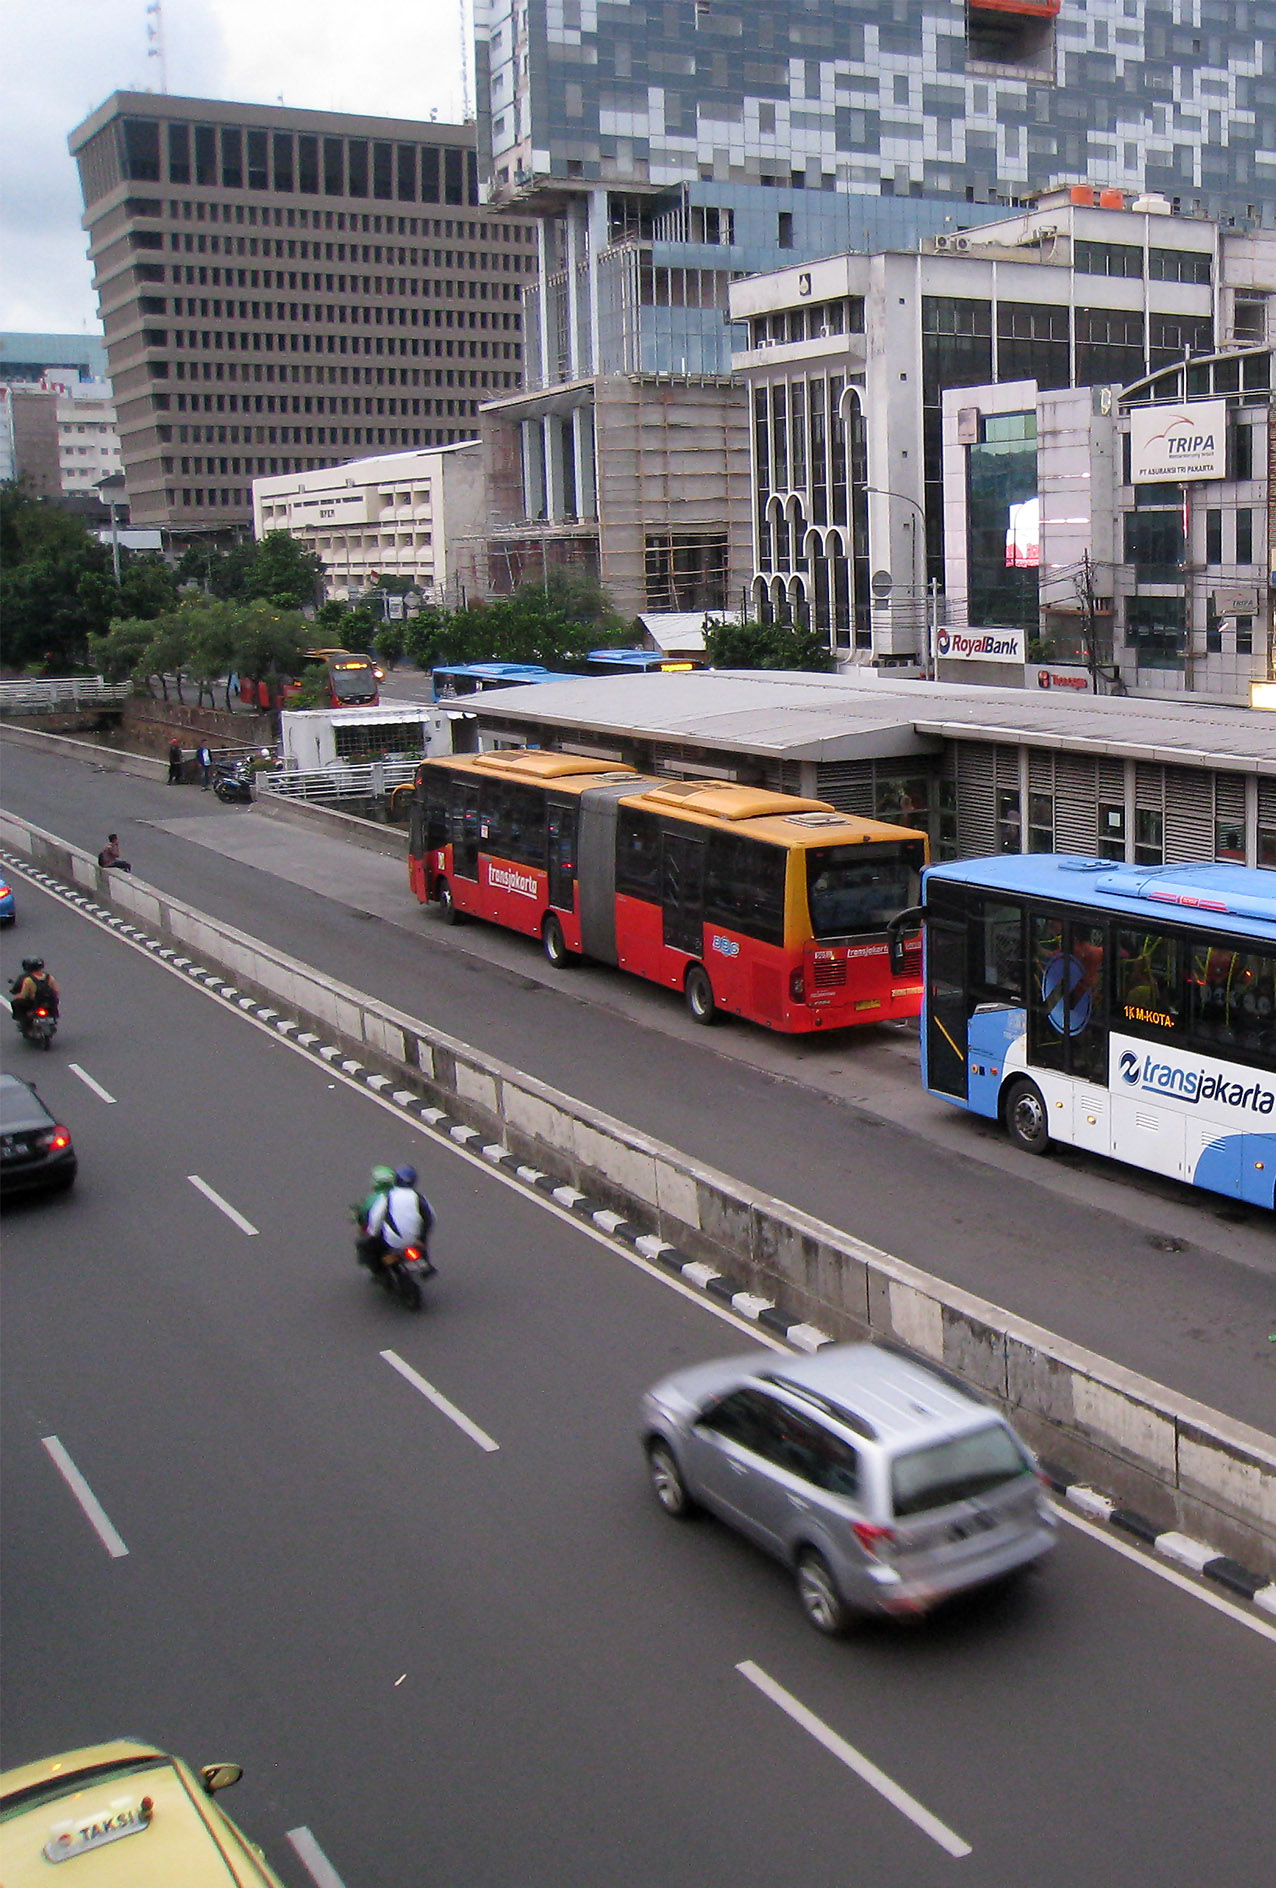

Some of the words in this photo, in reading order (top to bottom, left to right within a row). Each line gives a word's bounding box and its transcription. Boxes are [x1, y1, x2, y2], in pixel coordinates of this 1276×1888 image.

[1168, 434, 1214, 453] TRIPA
[1148, 467, 1176, 475] ASURANSI
[1187, 464, 1214, 472] PAKARTA
[952, 634, 1018, 657] RoyalBank
[488, 862, 538, 900] transjakarta
[1143, 1055, 1275, 1114] transjakarta
[80, 1810, 134, 1841] TAKSI
